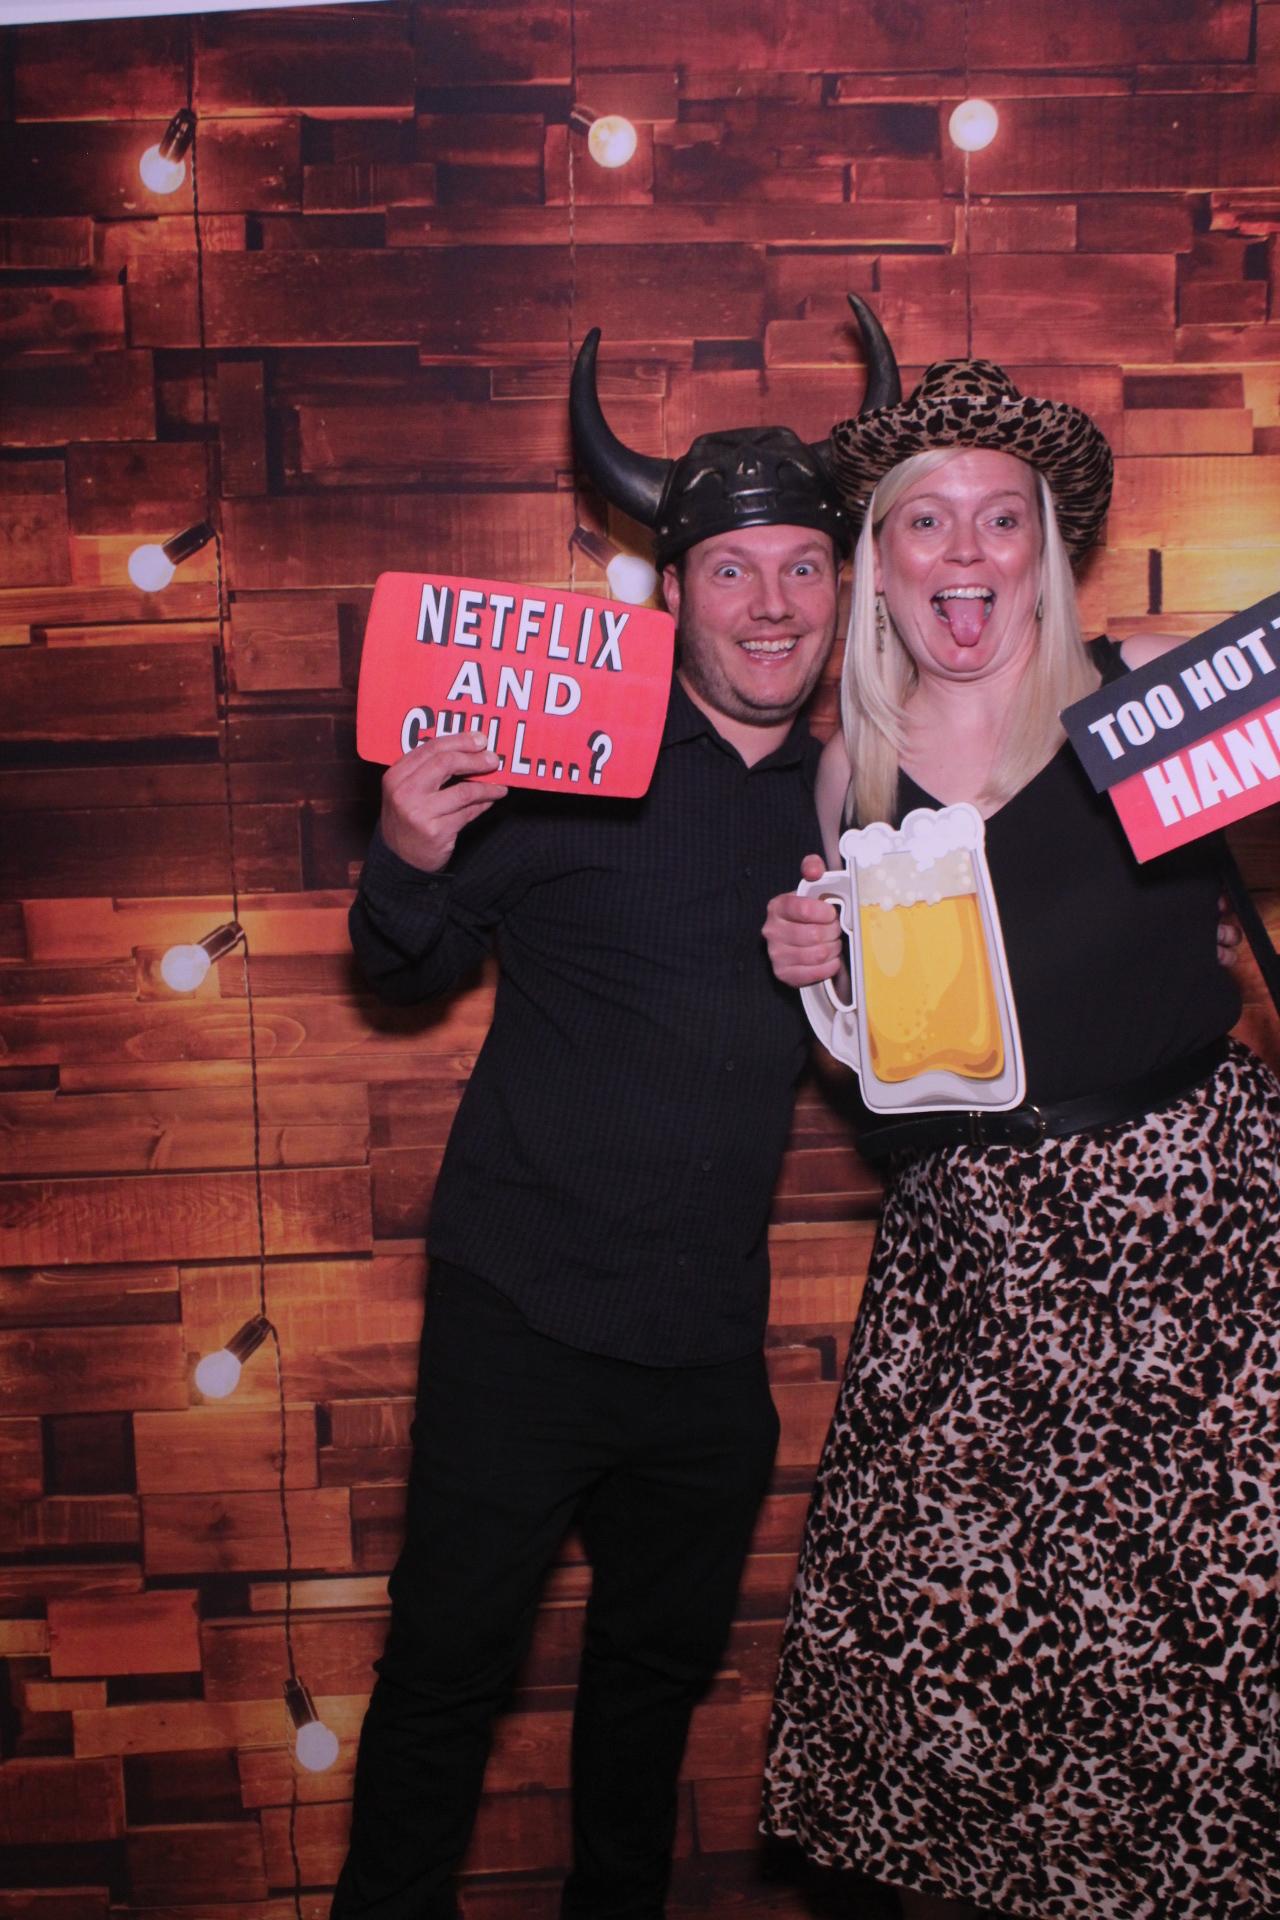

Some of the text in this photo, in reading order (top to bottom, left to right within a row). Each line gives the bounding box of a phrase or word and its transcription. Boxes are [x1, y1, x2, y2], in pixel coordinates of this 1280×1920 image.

[416, 583, 630, 672] NETFLIX
[446, 660, 582, 716] AND
[1087, 627, 1277, 760] TOO HOT
